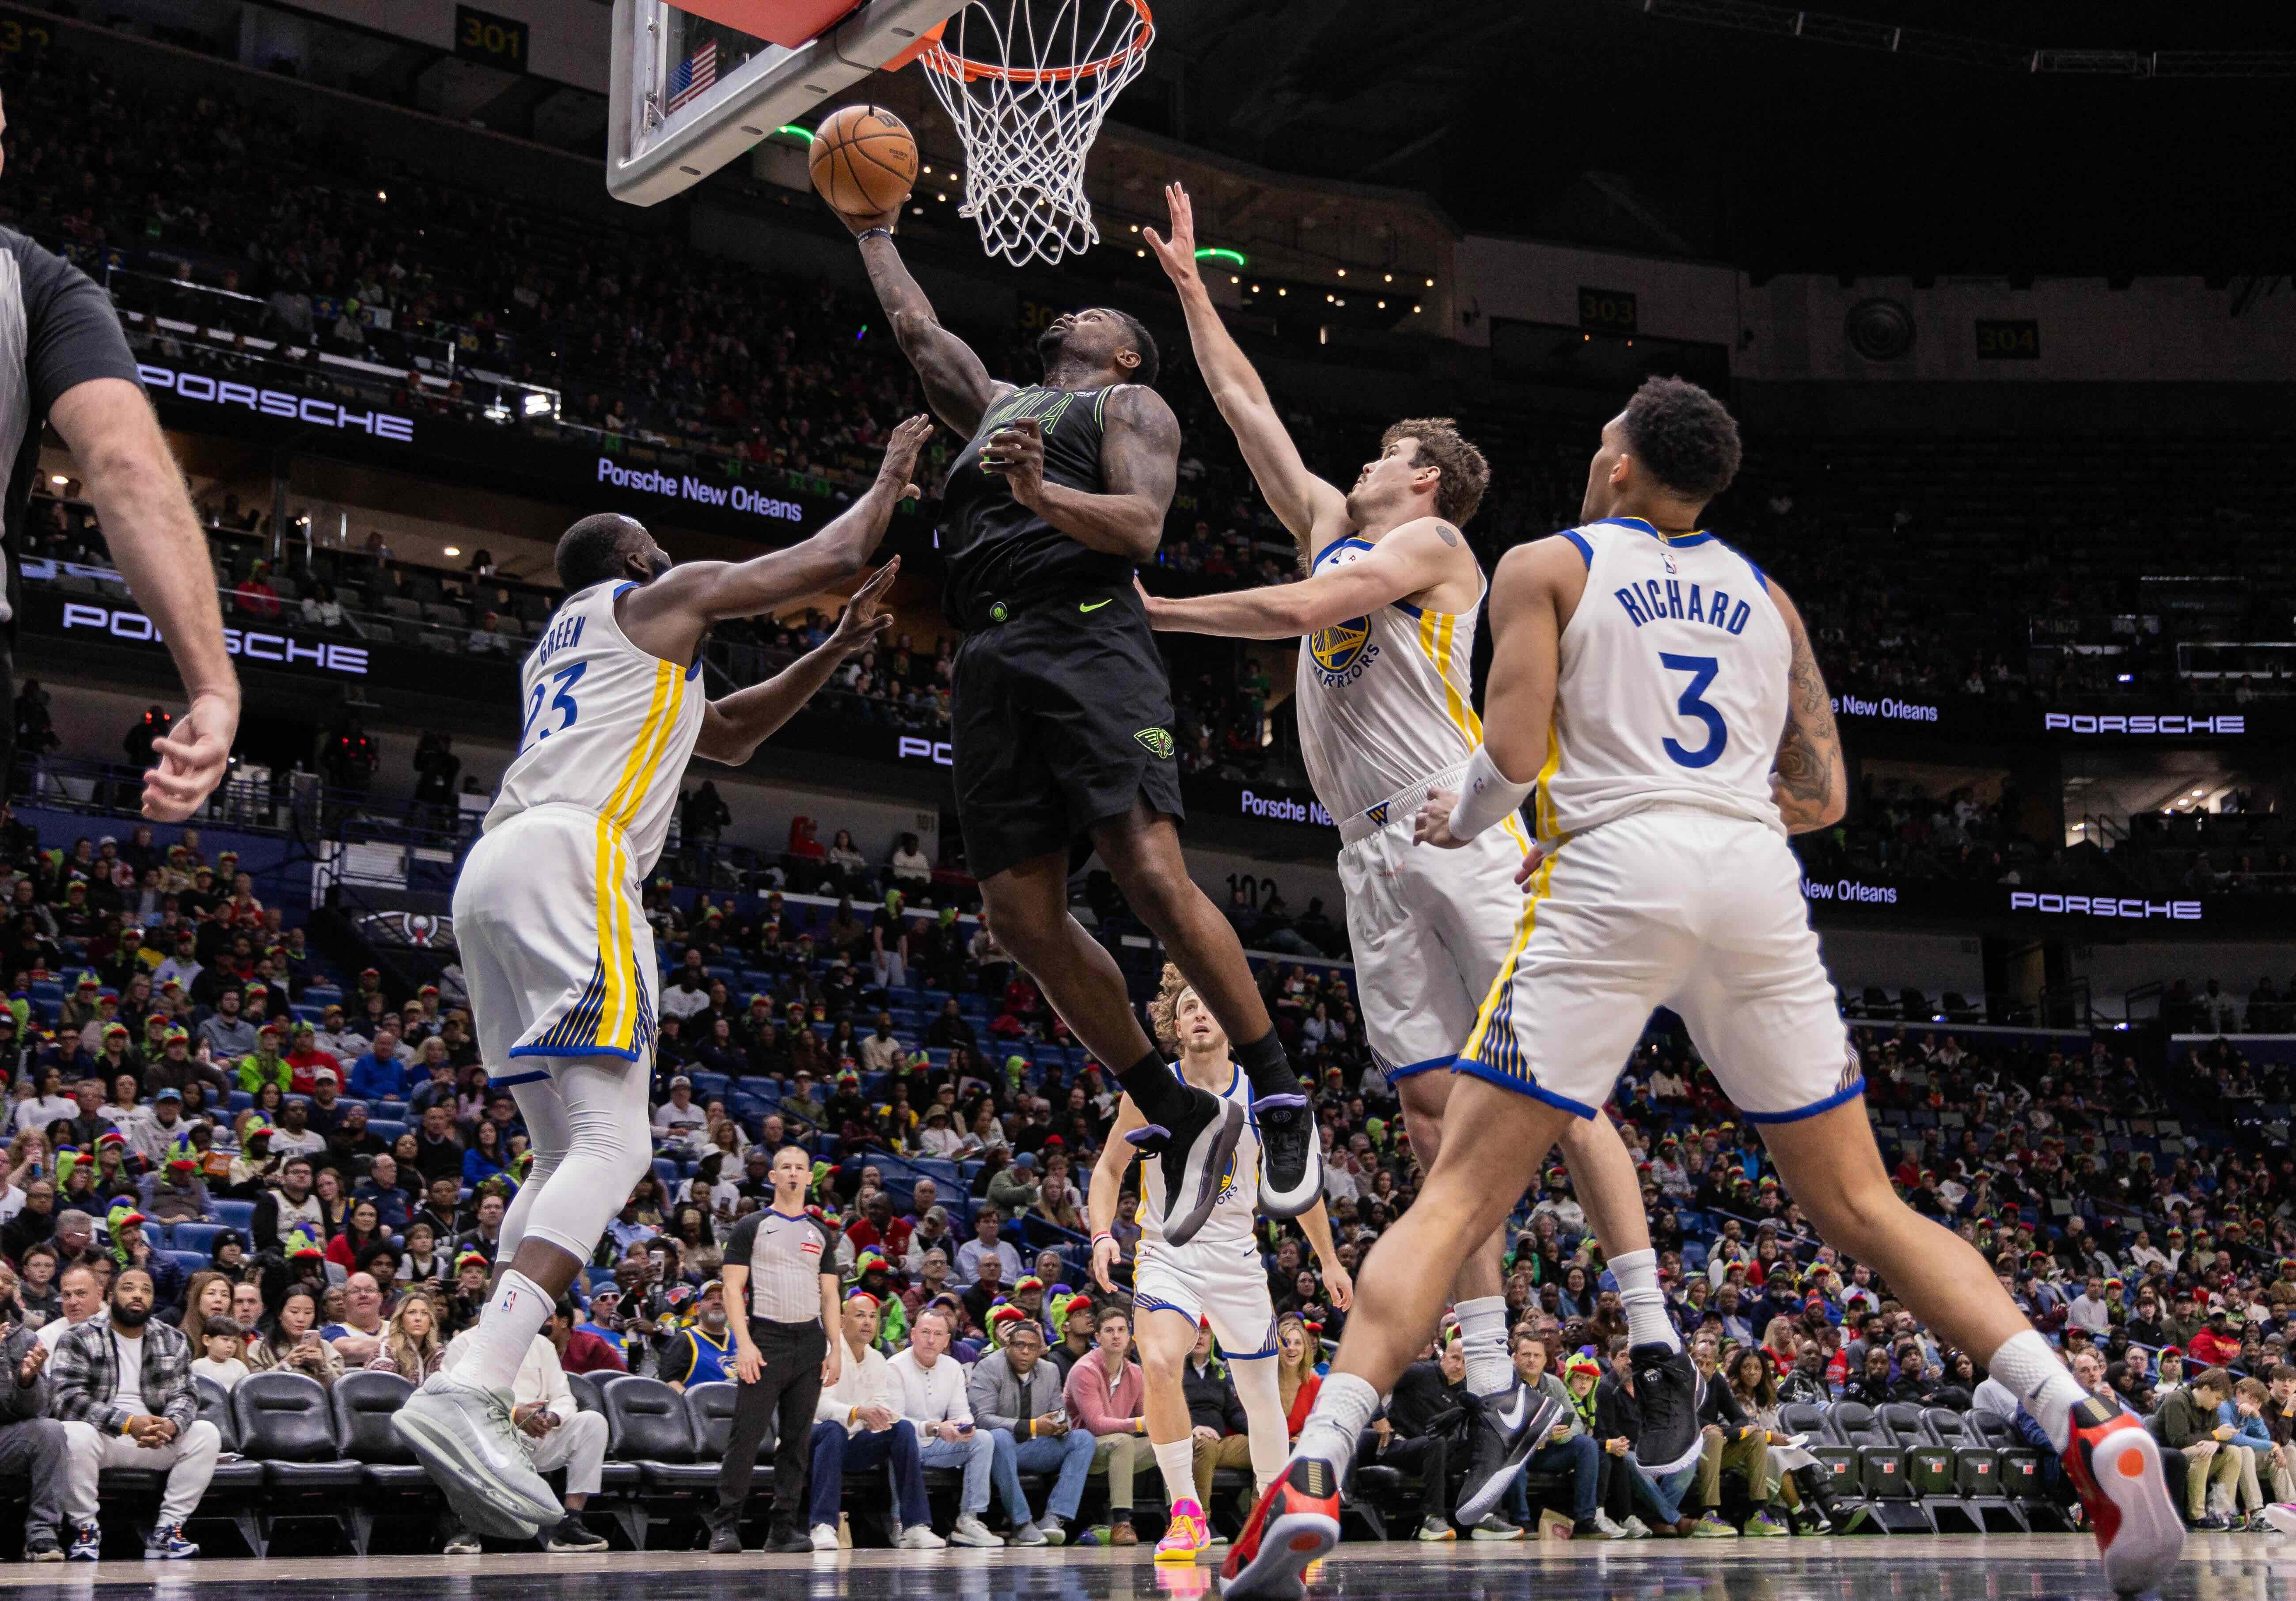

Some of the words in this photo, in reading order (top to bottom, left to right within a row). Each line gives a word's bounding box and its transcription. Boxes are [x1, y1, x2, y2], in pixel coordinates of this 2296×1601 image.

[465, 16, 520, 57] 301
[1583, 294, 1633, 326] 303
[1980, 325, 2034, 351] 304
[134, 363, 414, 442] PORSCHE
[598, 457, 677, 497] Porsche
[682, 475, 727, 506] New
[731, 485, 802, 522] Orleans
[1614, 579, 1751, 635] RICHARD
[63, 602, 369, 674] POSCHE
[540, 616, 587, 666] GREEN
[519, 661, 588, 757] 23
[1658, 652, 1727, 769] 3
[1843, 694, 1878, 716] New
[1881, 697, 1938, 722] Orleans
[2045, 712, 2245, 734] PORSCHE
[1241, 790, 1306, 822] Porsche
[1309, 801, 1336, 827] Ne
[1837, 879, 1897, 903] Orleans
[2011, 892, 2202, 920] PORSCHE
